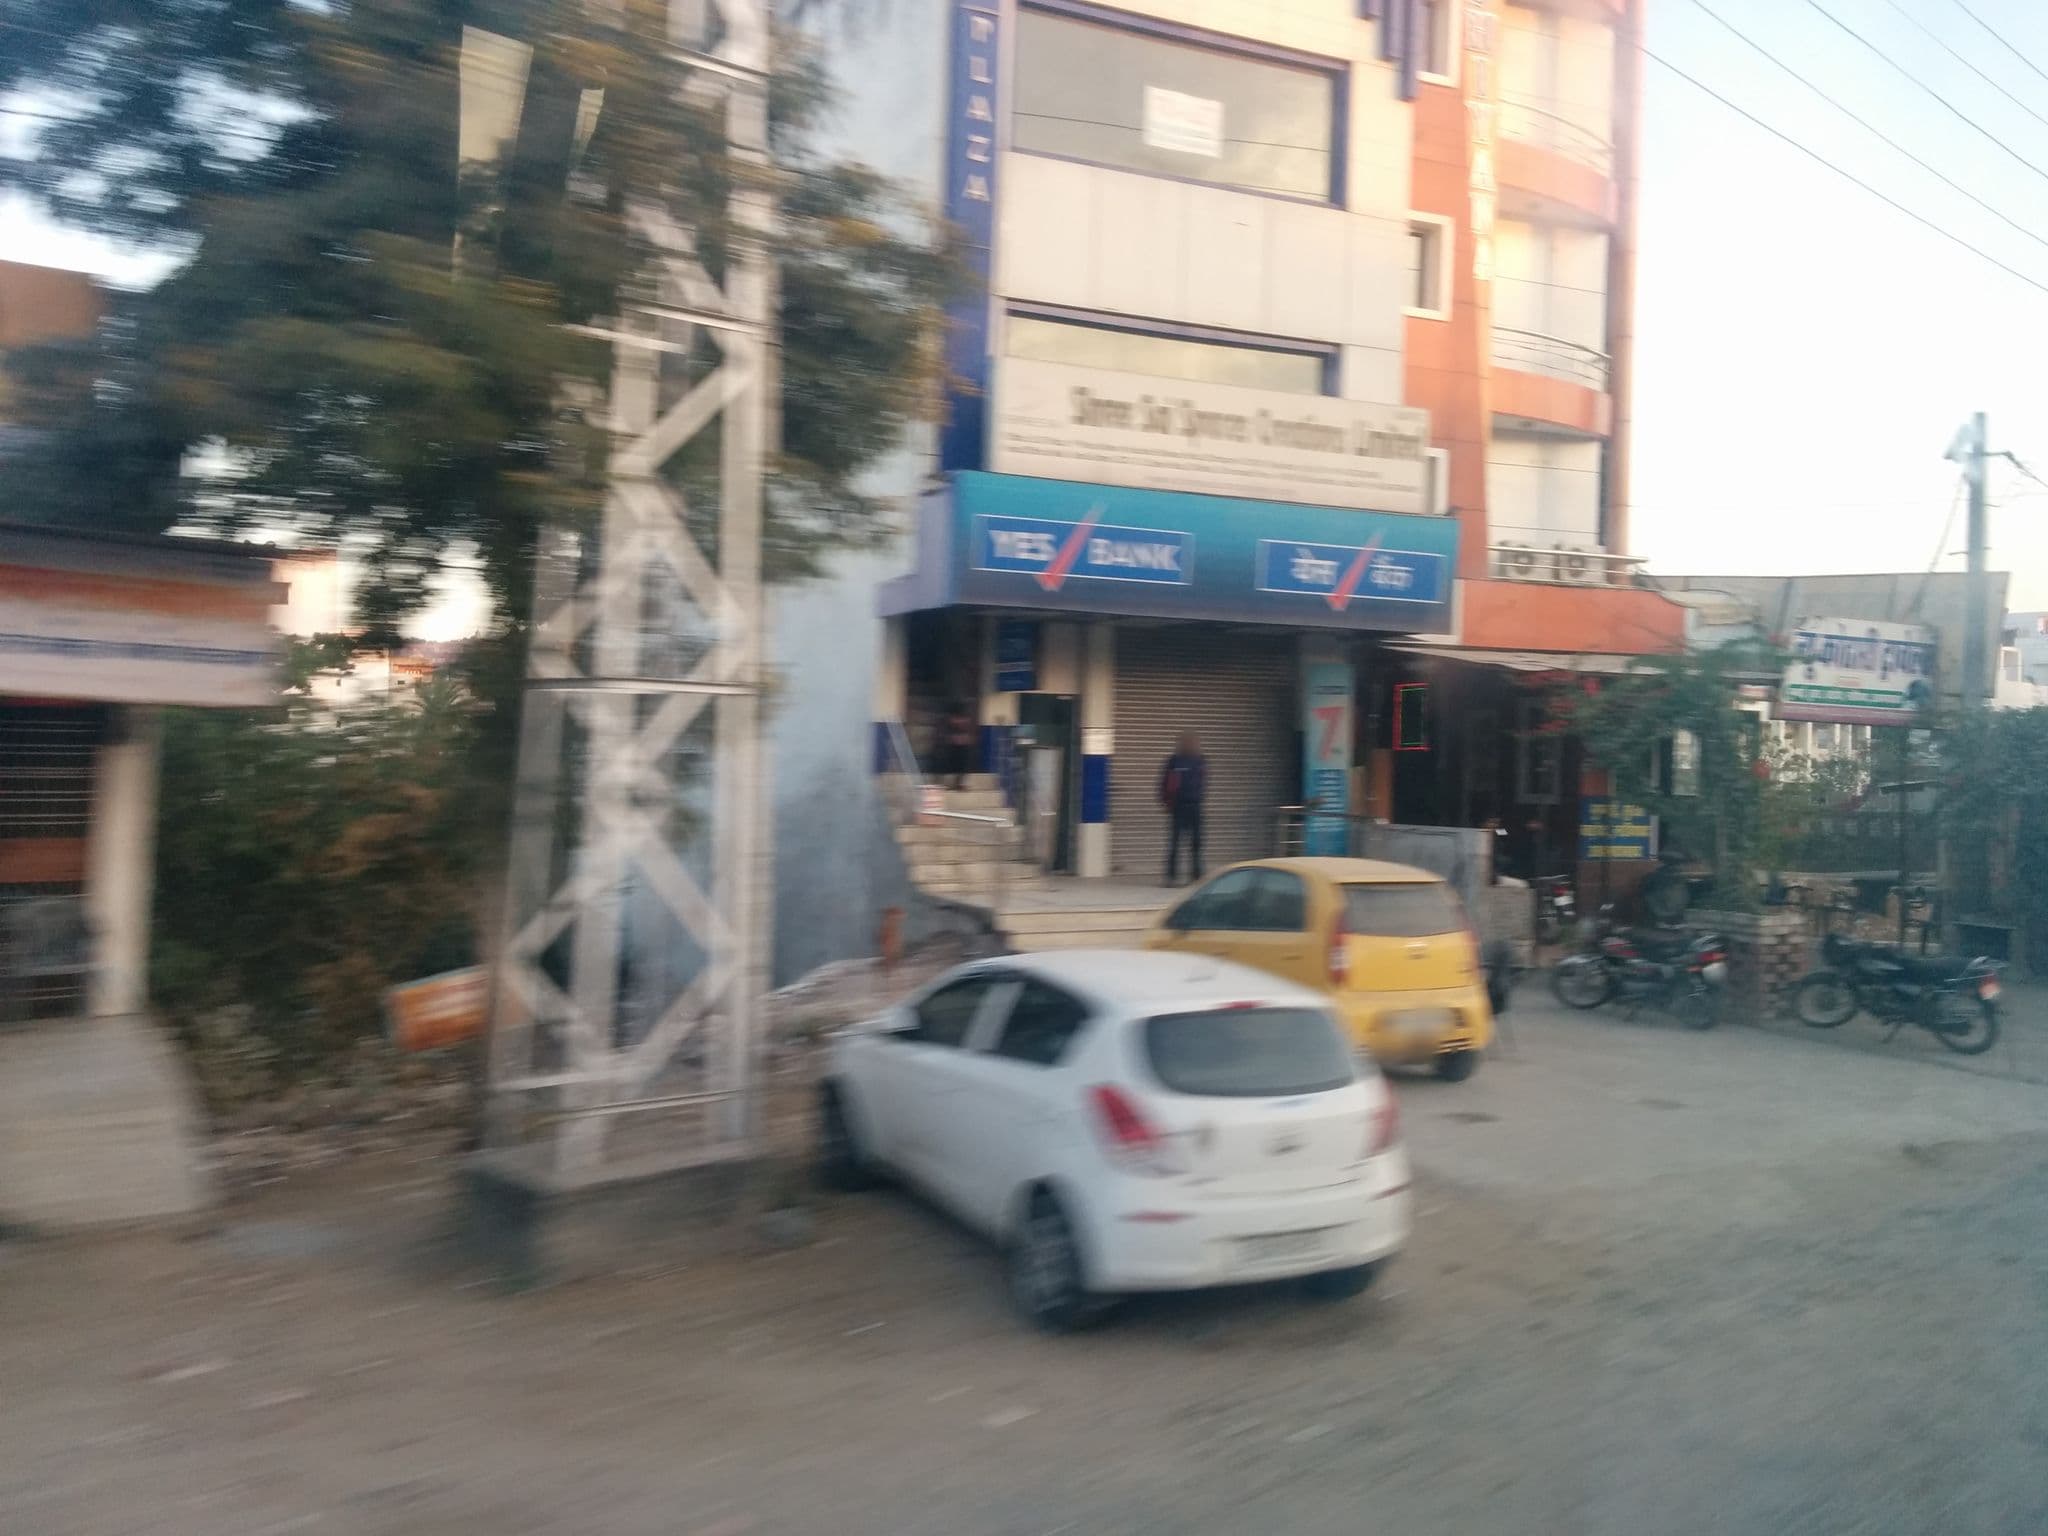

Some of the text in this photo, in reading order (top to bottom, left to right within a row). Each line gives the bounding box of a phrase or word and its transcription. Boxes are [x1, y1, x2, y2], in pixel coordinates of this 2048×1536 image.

[964, 15, 993, 200] PLAZA
[987, 529, 1182, 572] YES BANK
